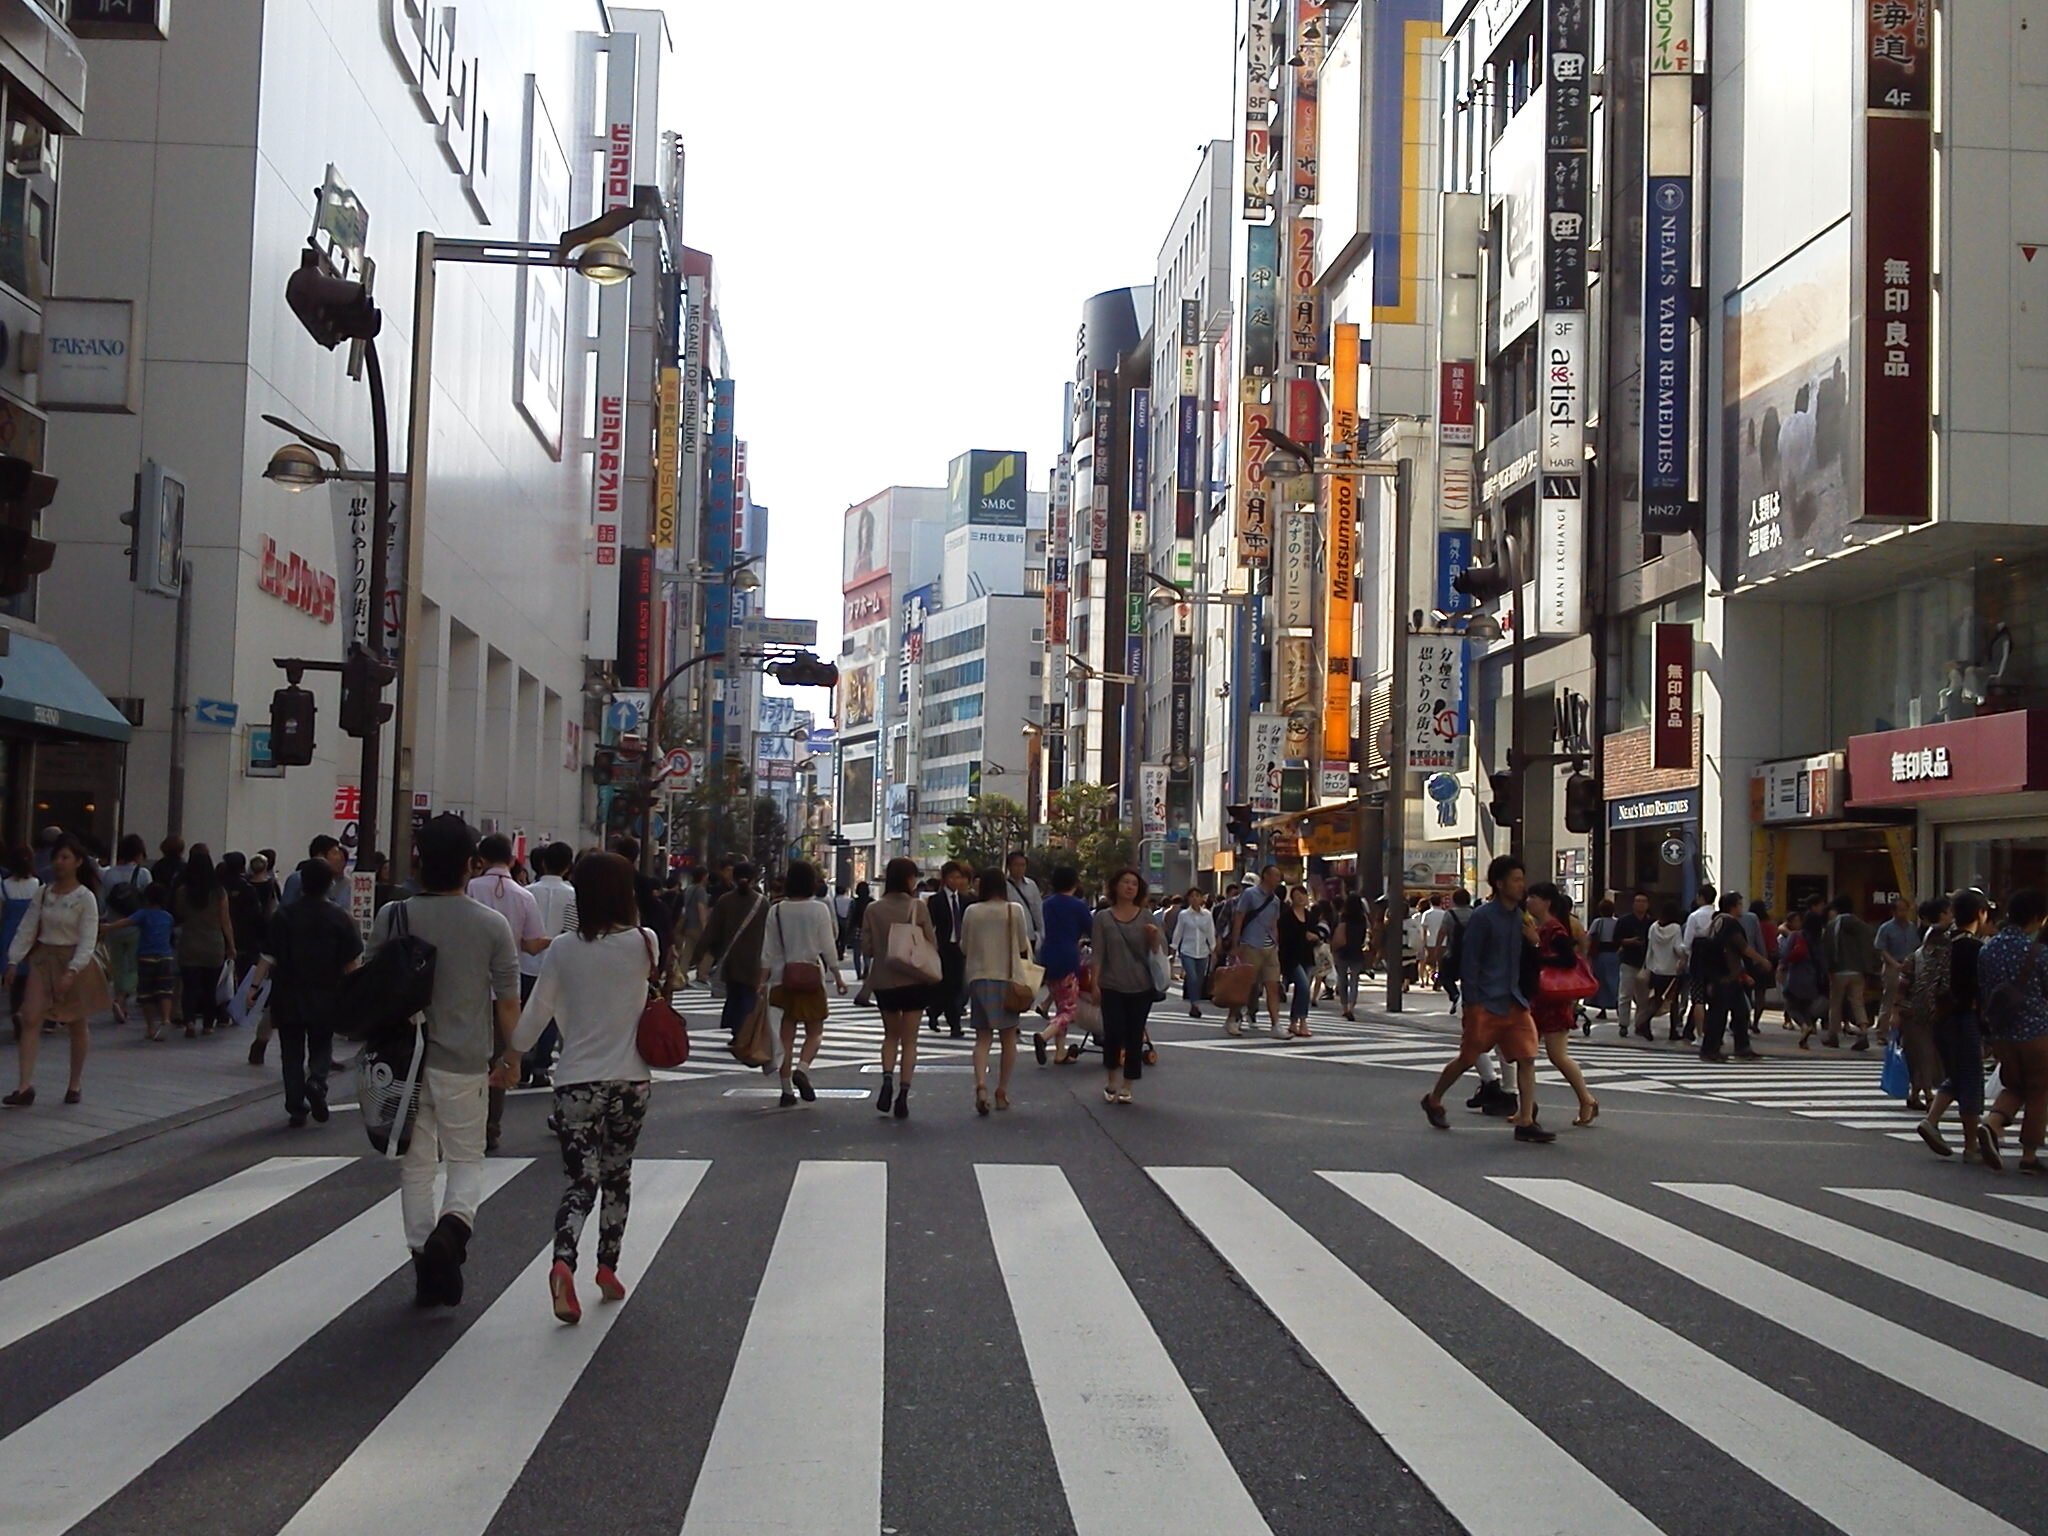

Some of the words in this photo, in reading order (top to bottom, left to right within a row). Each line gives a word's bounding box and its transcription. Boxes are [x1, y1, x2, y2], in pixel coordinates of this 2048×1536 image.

[1249, 97, 1266, 109] 8F
[1884, 88, 1912, 106] 4F
[1660, 216, 1677, 287] NEAL'S
[688, 304, 699, 358] MEGANE
[1554, 322, 1574, 336] 3F
[1659, 295, 1675, 353] YARD
[1883, 257, 1910, 378] 無印良品
[49, 337, 124, 356] TAKANO
[687, 361, 698, 387] TOP
[684, 390, 697, 454] SHINJUKU
[1658, 358, 1674, 475] REMEDIES
[1550, 458, 1575, 468] HAIR
[980, 498, 1016, 511] SMBC
[1748, 491, 1781, 528] 人類は
[1332, 484, 1352, 601] Matsumoto
[1556, 508, 1567, 571] EXCHANGE
[1556, 577, 1566, 626] ARMANI
[1439, 648, 1454, 690] 分煙で
[1415, 647, 1434, 749] 思いやりの街に。
[1667, 664, 1683, 728] 無印良品
[1891, 747, 1950, 782] 無印良品
